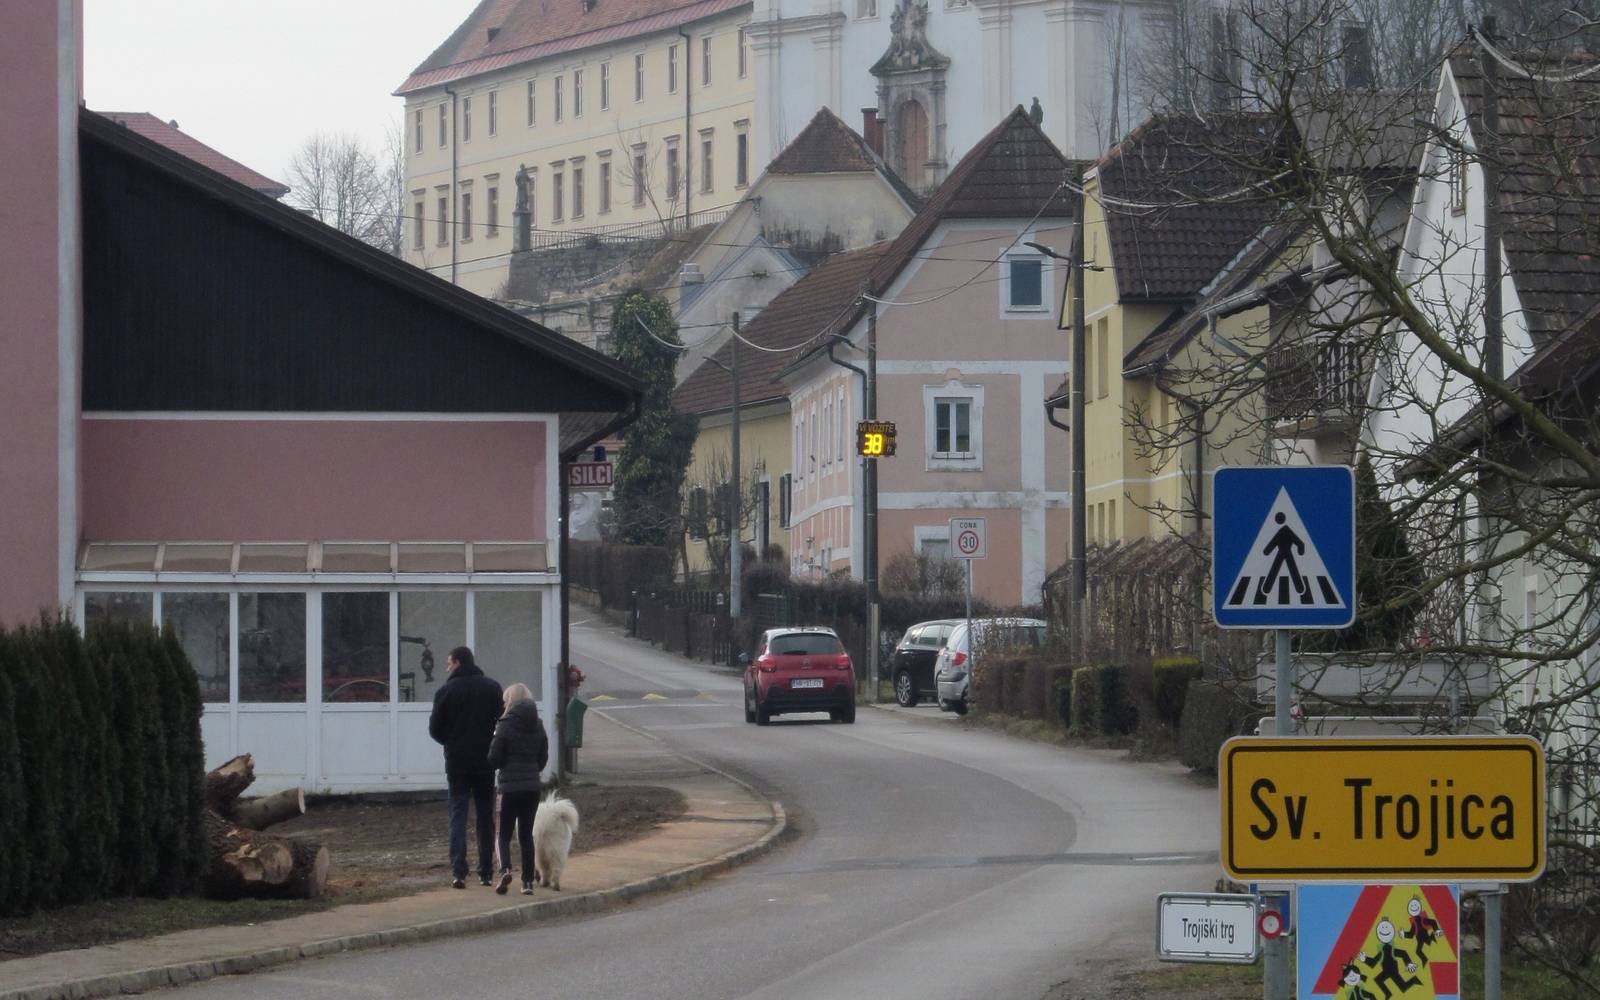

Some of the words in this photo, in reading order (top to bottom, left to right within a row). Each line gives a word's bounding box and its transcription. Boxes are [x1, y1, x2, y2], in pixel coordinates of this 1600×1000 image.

[863, 433, 883, 454] 38
[570, 465, 611, 485] SILCI
[962, 536, 975, 549] 30
[1250, 778, 1321, 840] Sv.
[1344, 778, 1514, 856] Trojica
[1182, 918, 1218, 943] Trojiški
[1220, 922, 1235, 944] trg
